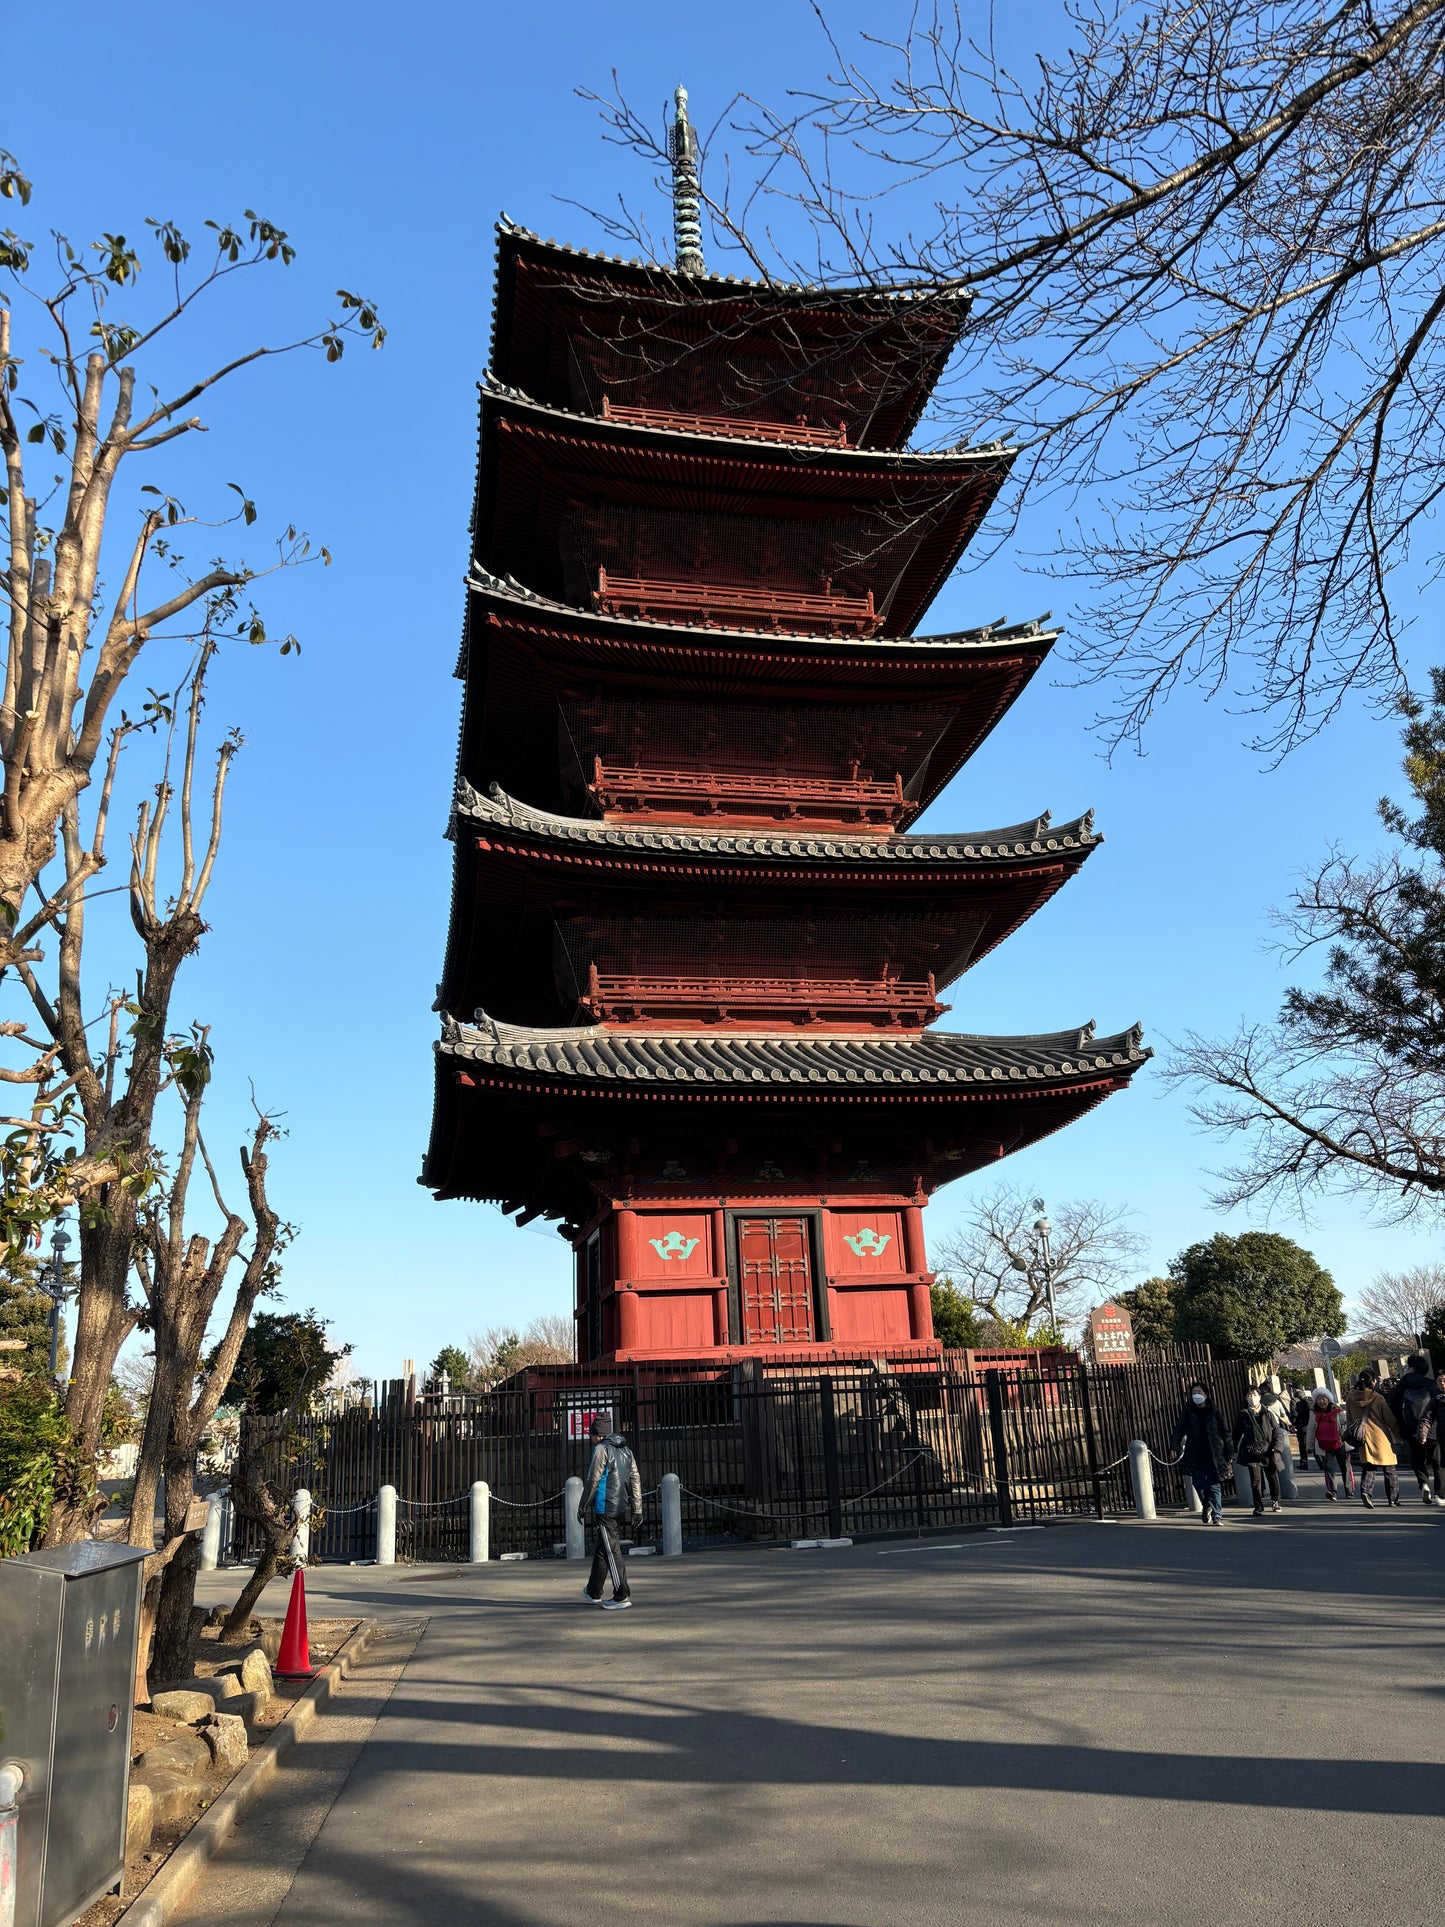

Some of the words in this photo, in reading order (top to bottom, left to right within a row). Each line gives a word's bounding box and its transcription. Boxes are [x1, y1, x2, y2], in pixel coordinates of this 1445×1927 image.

[1096, 1331, 1130, 1340] 池上本門寺
